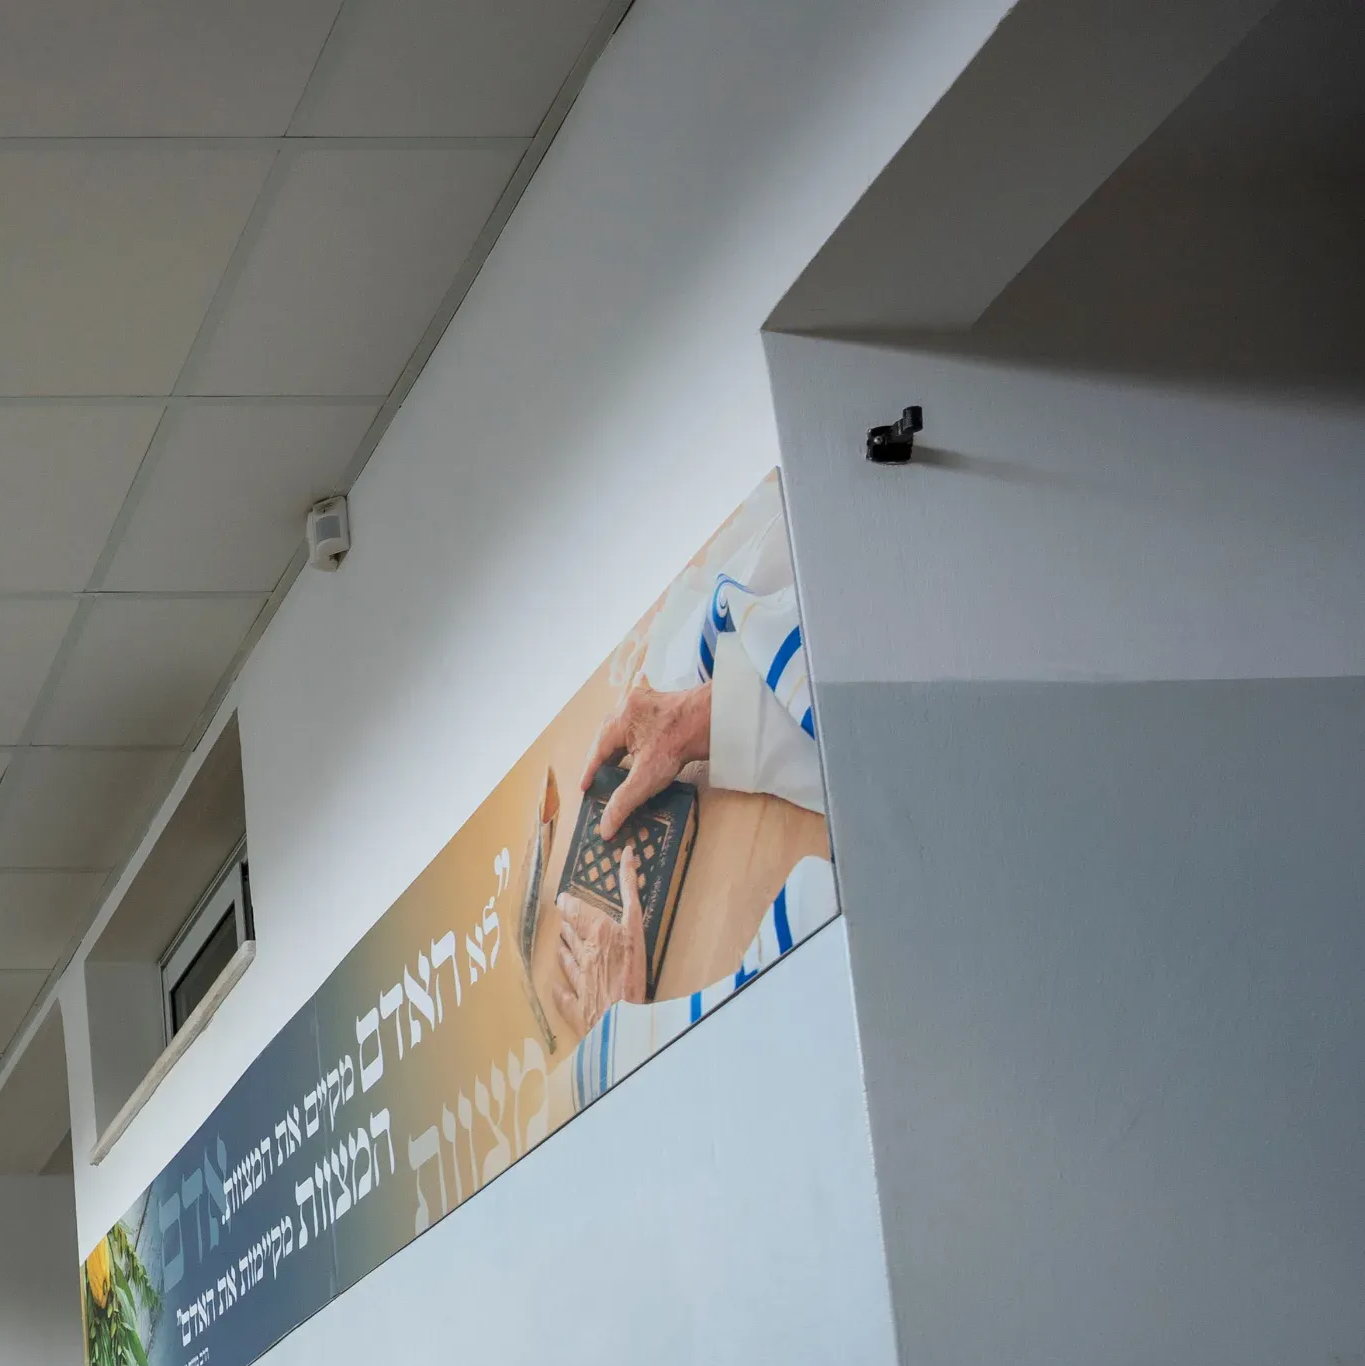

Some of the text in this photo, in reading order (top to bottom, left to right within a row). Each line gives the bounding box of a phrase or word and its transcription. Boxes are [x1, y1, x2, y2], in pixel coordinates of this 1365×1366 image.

[356, 933, 460, 1090] האדם
[274, 1105, 302, 1166] את
[303, 1055, 354, 1137] מקיים
[407, 1037, 550, 1237] מצוות
[295, 1110, 394, 1247] המצוות
[216, 1265, 238, 1315] את
[238, 1216, 293, 1295] מקיימות
